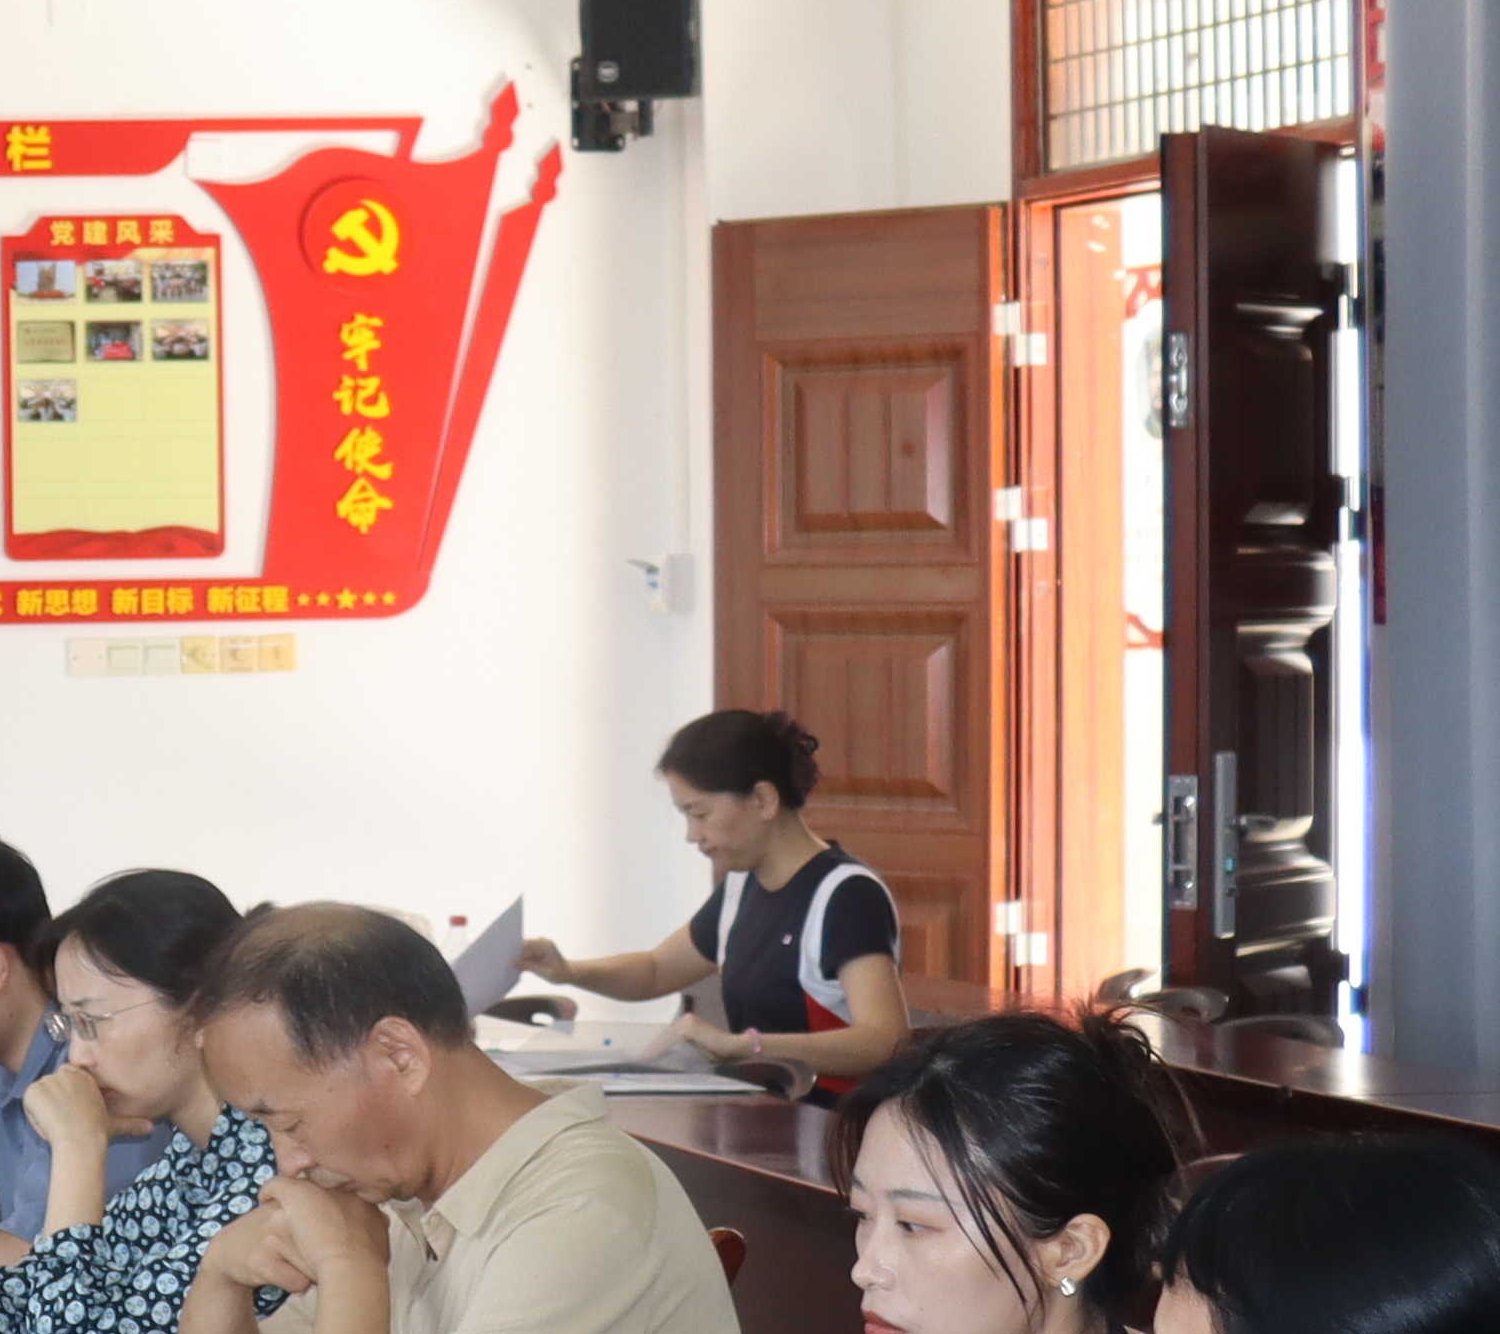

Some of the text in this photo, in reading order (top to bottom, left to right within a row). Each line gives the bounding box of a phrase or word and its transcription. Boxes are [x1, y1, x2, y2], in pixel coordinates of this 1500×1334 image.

[49, 218, 176, 246] 党建风采
[331, 312, 395, 535] 牢记使命
[16, 588, 100, 616] 新思想
[111, 586, 195, 615] 新目标
[206, 585, 290, 614] 新征程
